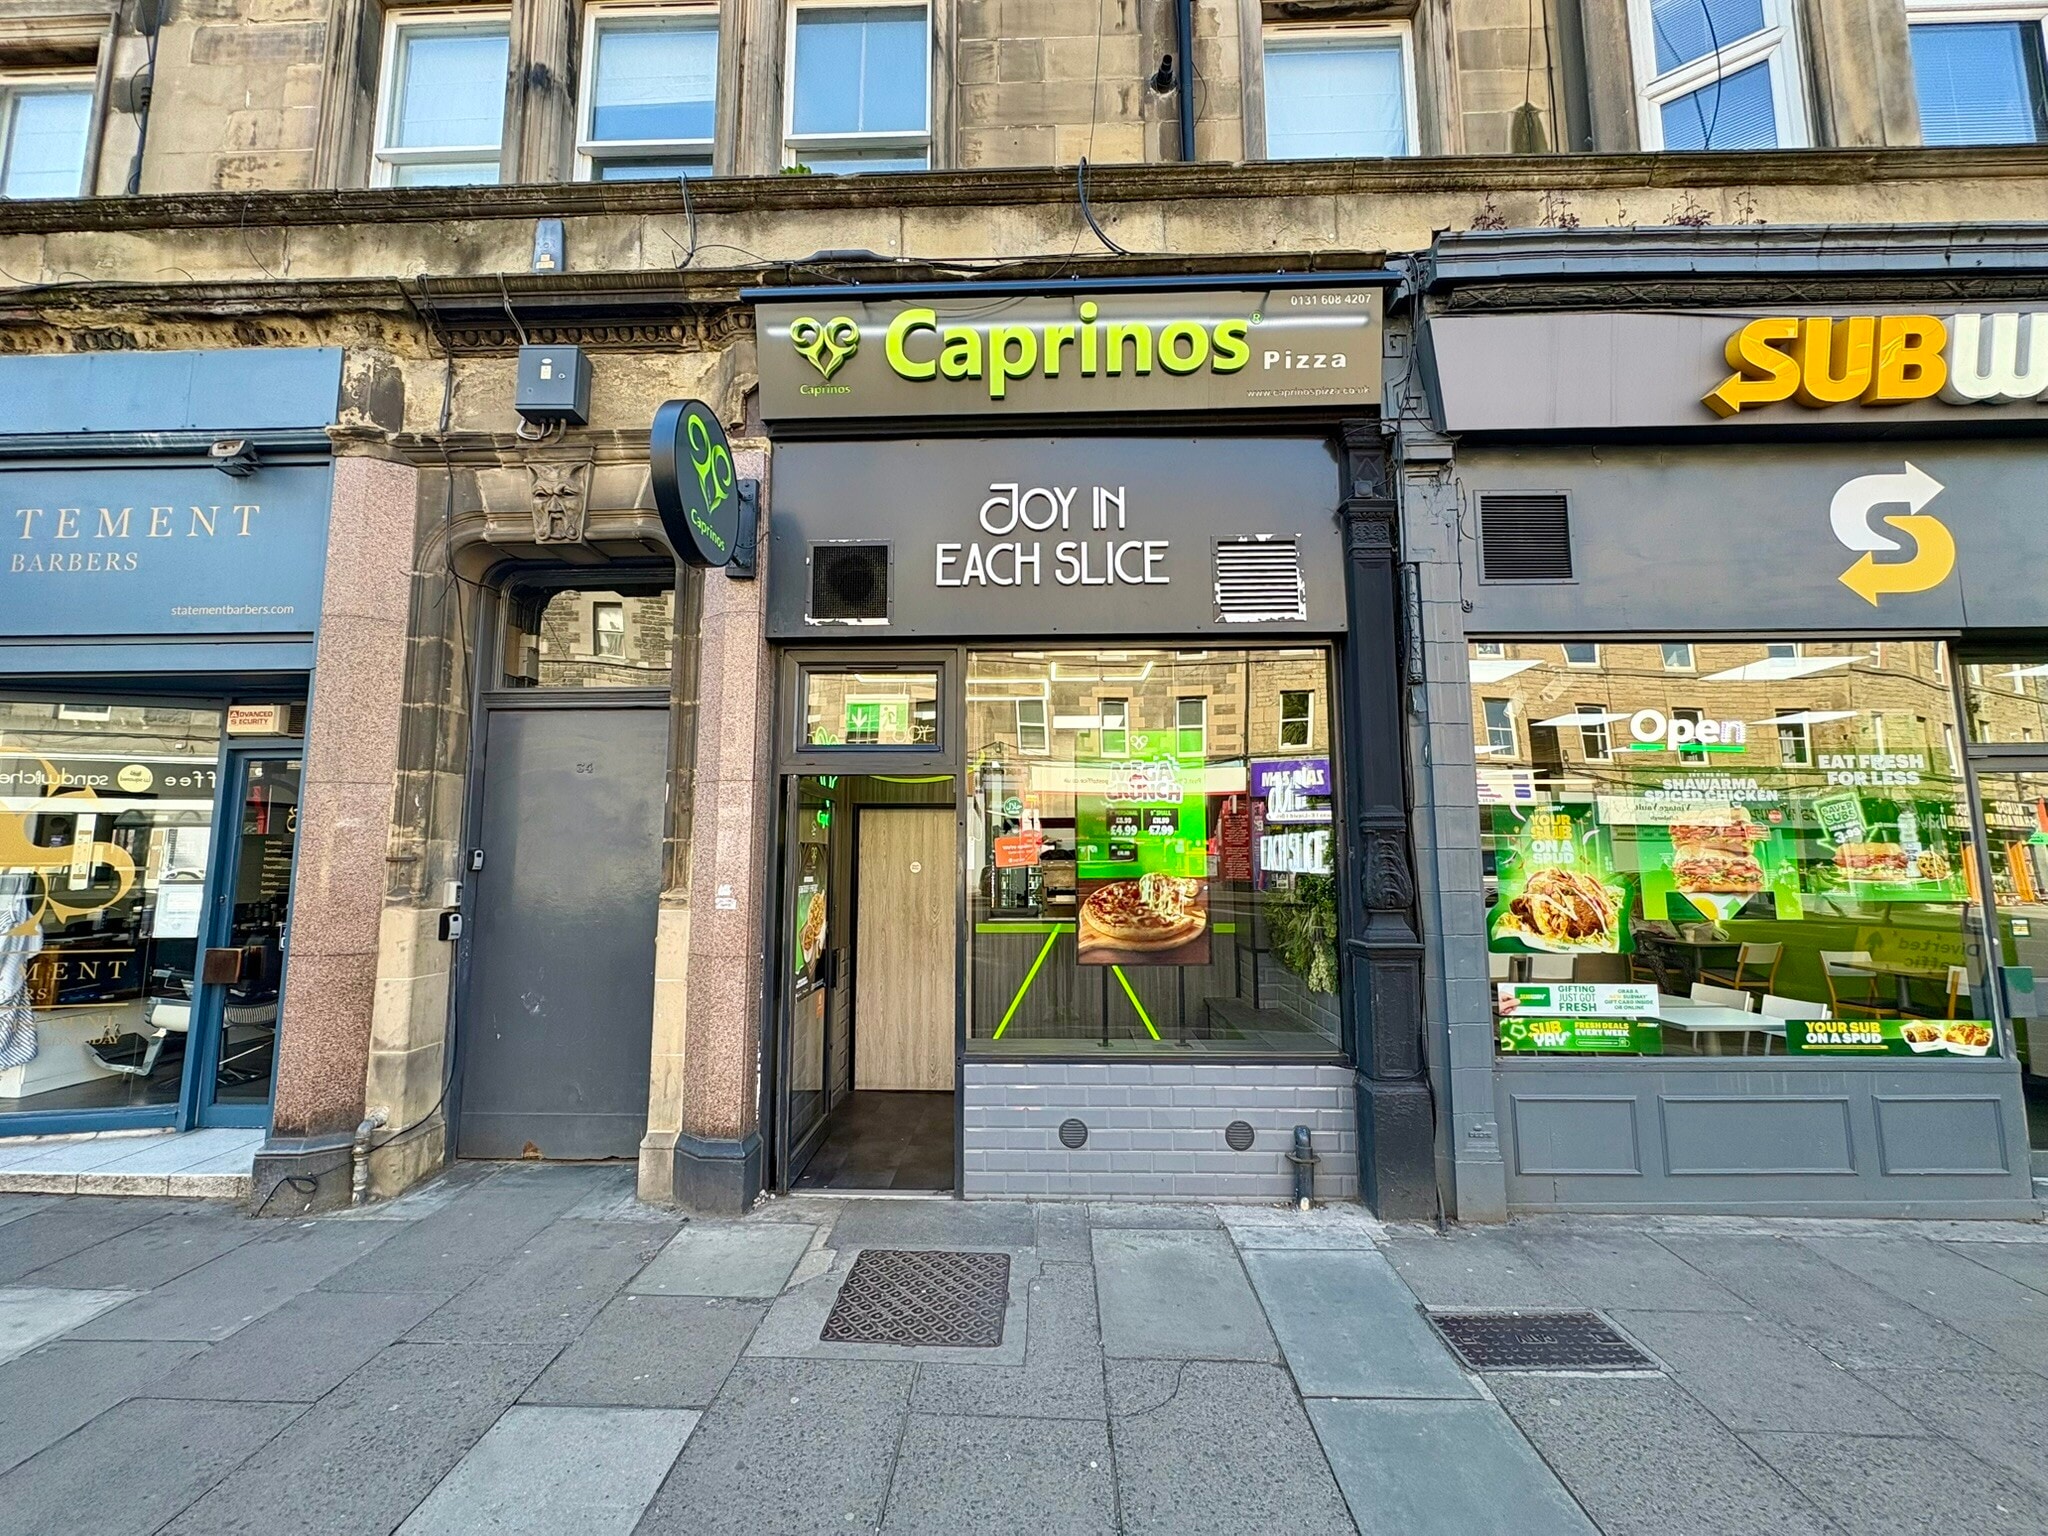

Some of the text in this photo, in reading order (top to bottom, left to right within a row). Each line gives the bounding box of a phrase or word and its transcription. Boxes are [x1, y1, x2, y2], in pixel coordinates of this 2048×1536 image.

[1290, 293, 1372, 306] 0131 608 4207
[885, 301, 1251, 400] Caprinos
[1263, 350, 1348, 370] Pizza
[799, 383, 851, 397] Caprinos
[1247, 384, 1371, 398] www.caprinospizza.co.uk
[978, 482, 1126, 536] JOY IN
[16, 504, 260, 540] TEMENT
[690, 508, 726, 552] Caprinos
[9, 552, 139, 573] BARBERS
[935, 540, 1170, 588] EACH SLICE
[170, 603, 295, 616] statementbarbers.com
[1629, 708, 1748, 752] Open
[1818, 754, 1925, 770] EAT FRESH
[1662, 778, 1759, 791] SHAWARMA
[1827, 771, 1921, 786] FOR LESS
[1644, 789, 1779, 802] SPICED CHICKEN
[1821, 800, 1854, 816] SAVER
[1530, 814, 1572, 827] YOUR
[1824, 810, 1858, 826] SUBS
[1110, 825, 1175, 837] £4.99 £7.99
[1530, 826, 1573, 840] SUB
[1531, 840, 1575, 854] ON A
[1532, 853, 1575, 865] SPUD
[1557, 985, 1596, 993] GIFTING
[1558, 993, 1596, 1003] JUST GOT
[1559, 1002, 1598, 1012] FRESH
[1529, 1020, 1563, 1035] SUB
[1574, 1021, 1630, 1030] FRESH DEALS
[1574, 1028, 1630, 1037] EVERY WEEK
[1804, 1021, 1882, 1034] YOUR SUB
[1805, 1033, 1883, 1044] ON A SPUD
